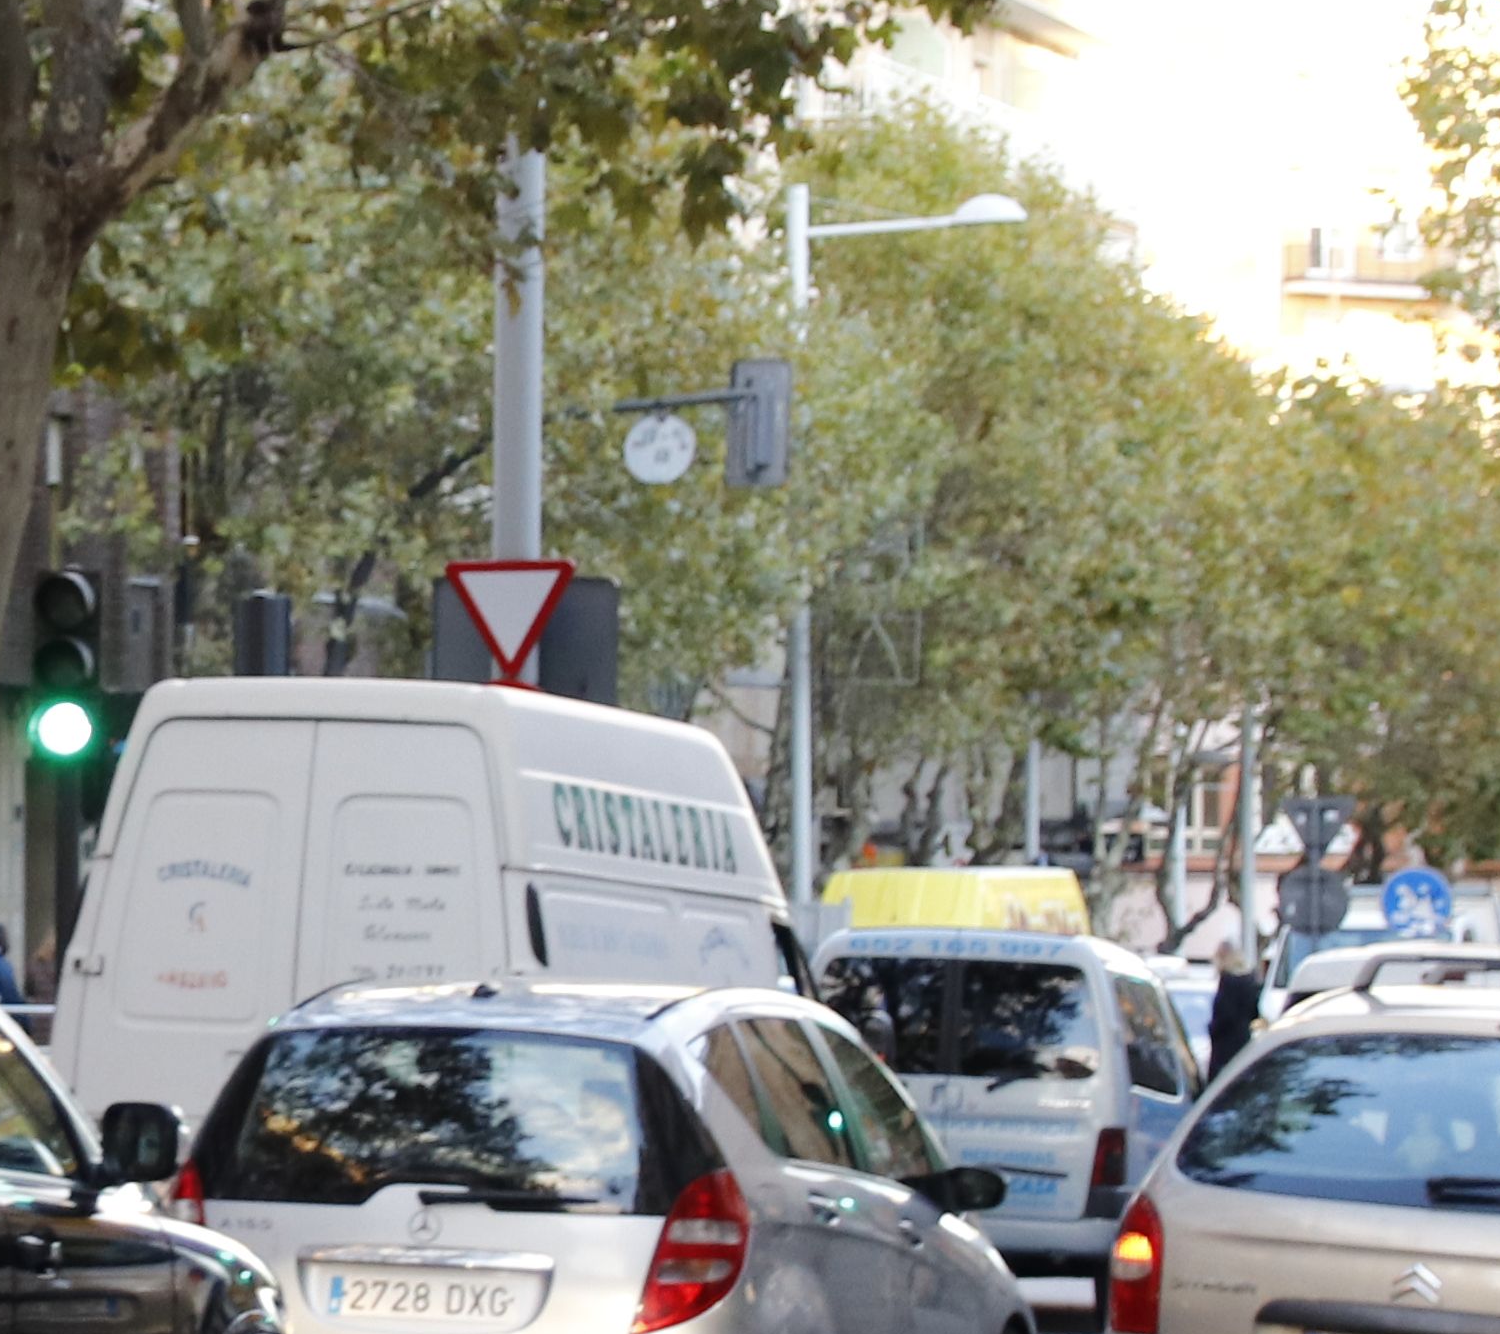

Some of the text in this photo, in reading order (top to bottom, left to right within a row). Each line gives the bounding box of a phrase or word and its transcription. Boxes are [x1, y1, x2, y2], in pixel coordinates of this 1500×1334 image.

[553, 781, 737, 875] CRISTALERIA
[351, 1279, 510, 1317] 2728 DXG
